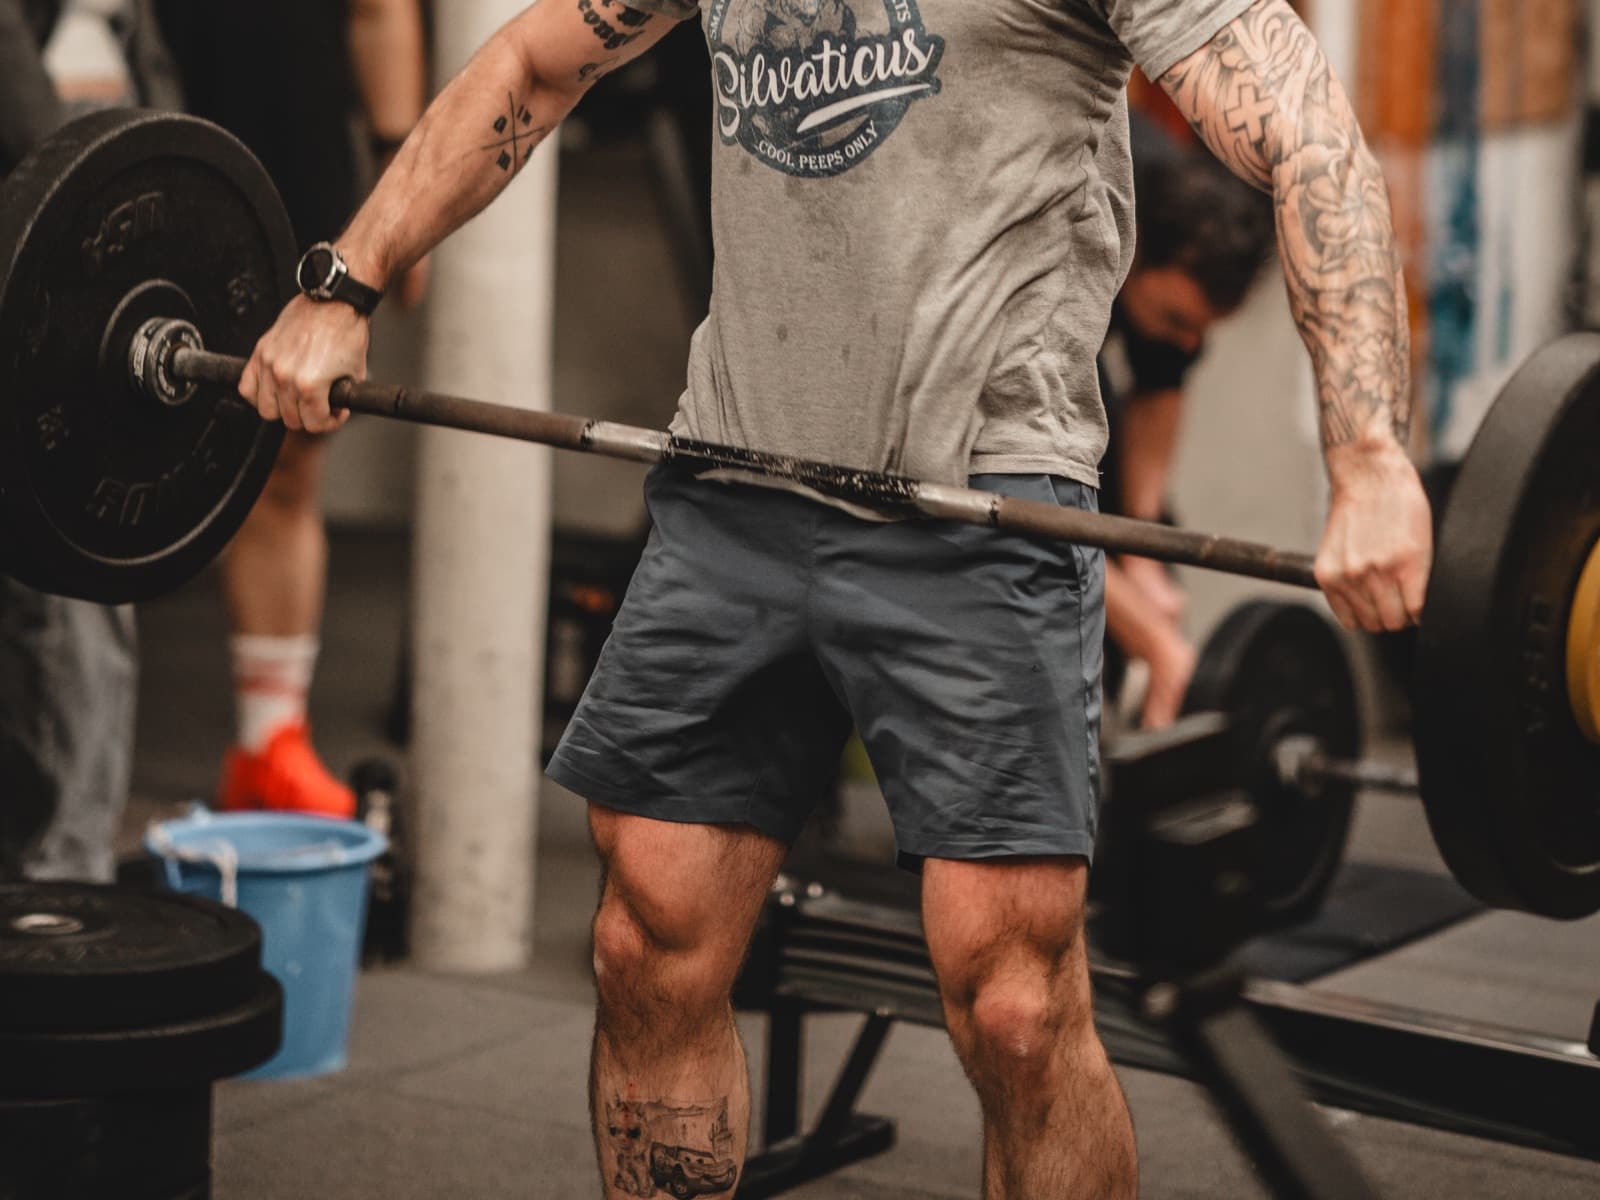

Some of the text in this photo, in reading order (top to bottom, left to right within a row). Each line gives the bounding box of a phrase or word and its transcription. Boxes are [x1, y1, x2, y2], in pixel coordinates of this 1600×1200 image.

[713, 28, 935, 137] Silvaticus
[757, 119, 880, 170] COOL PEEPS ONLY
